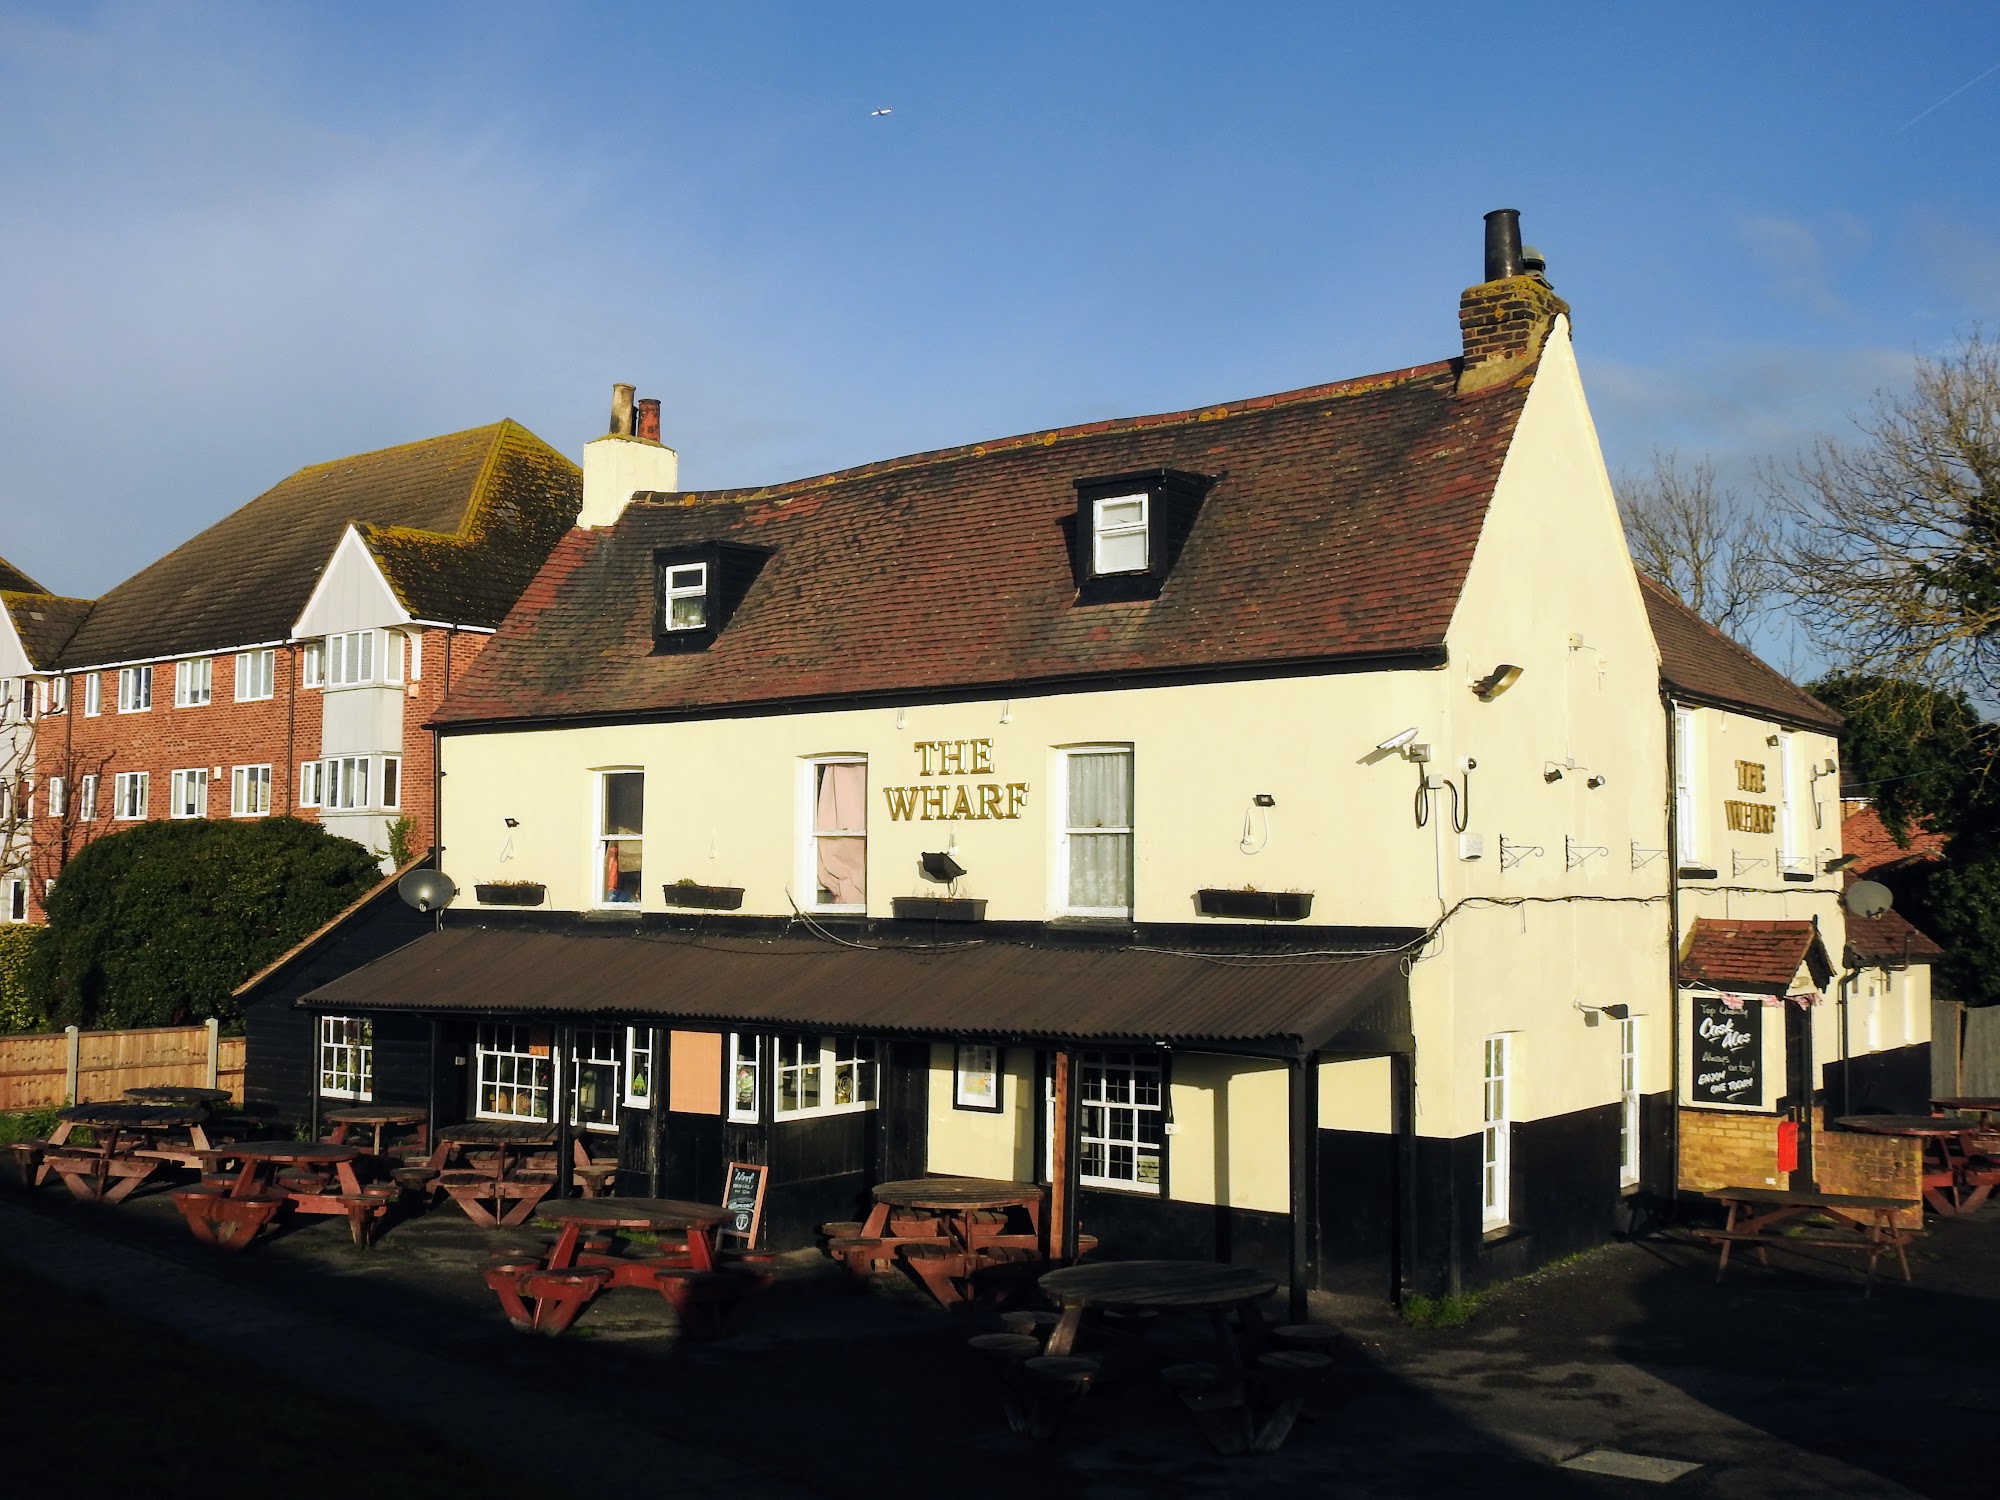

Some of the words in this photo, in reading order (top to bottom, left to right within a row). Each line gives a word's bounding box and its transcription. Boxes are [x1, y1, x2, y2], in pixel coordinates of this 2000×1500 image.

[914, 738, 995, 776] THE
[883, 783, 1030, 821] WHARF
[1698, 1017, 1734, 1039] Cask
[1721, 1031, 1752, 1049] Ales
[1701, 1051, 1731, 1065] Always
[1698, 1070, 1726, 1085] ENJOY
[1710, 1082, 1727, 1094] ONE
[1727, 1077, 1754, 1091] TODAY
